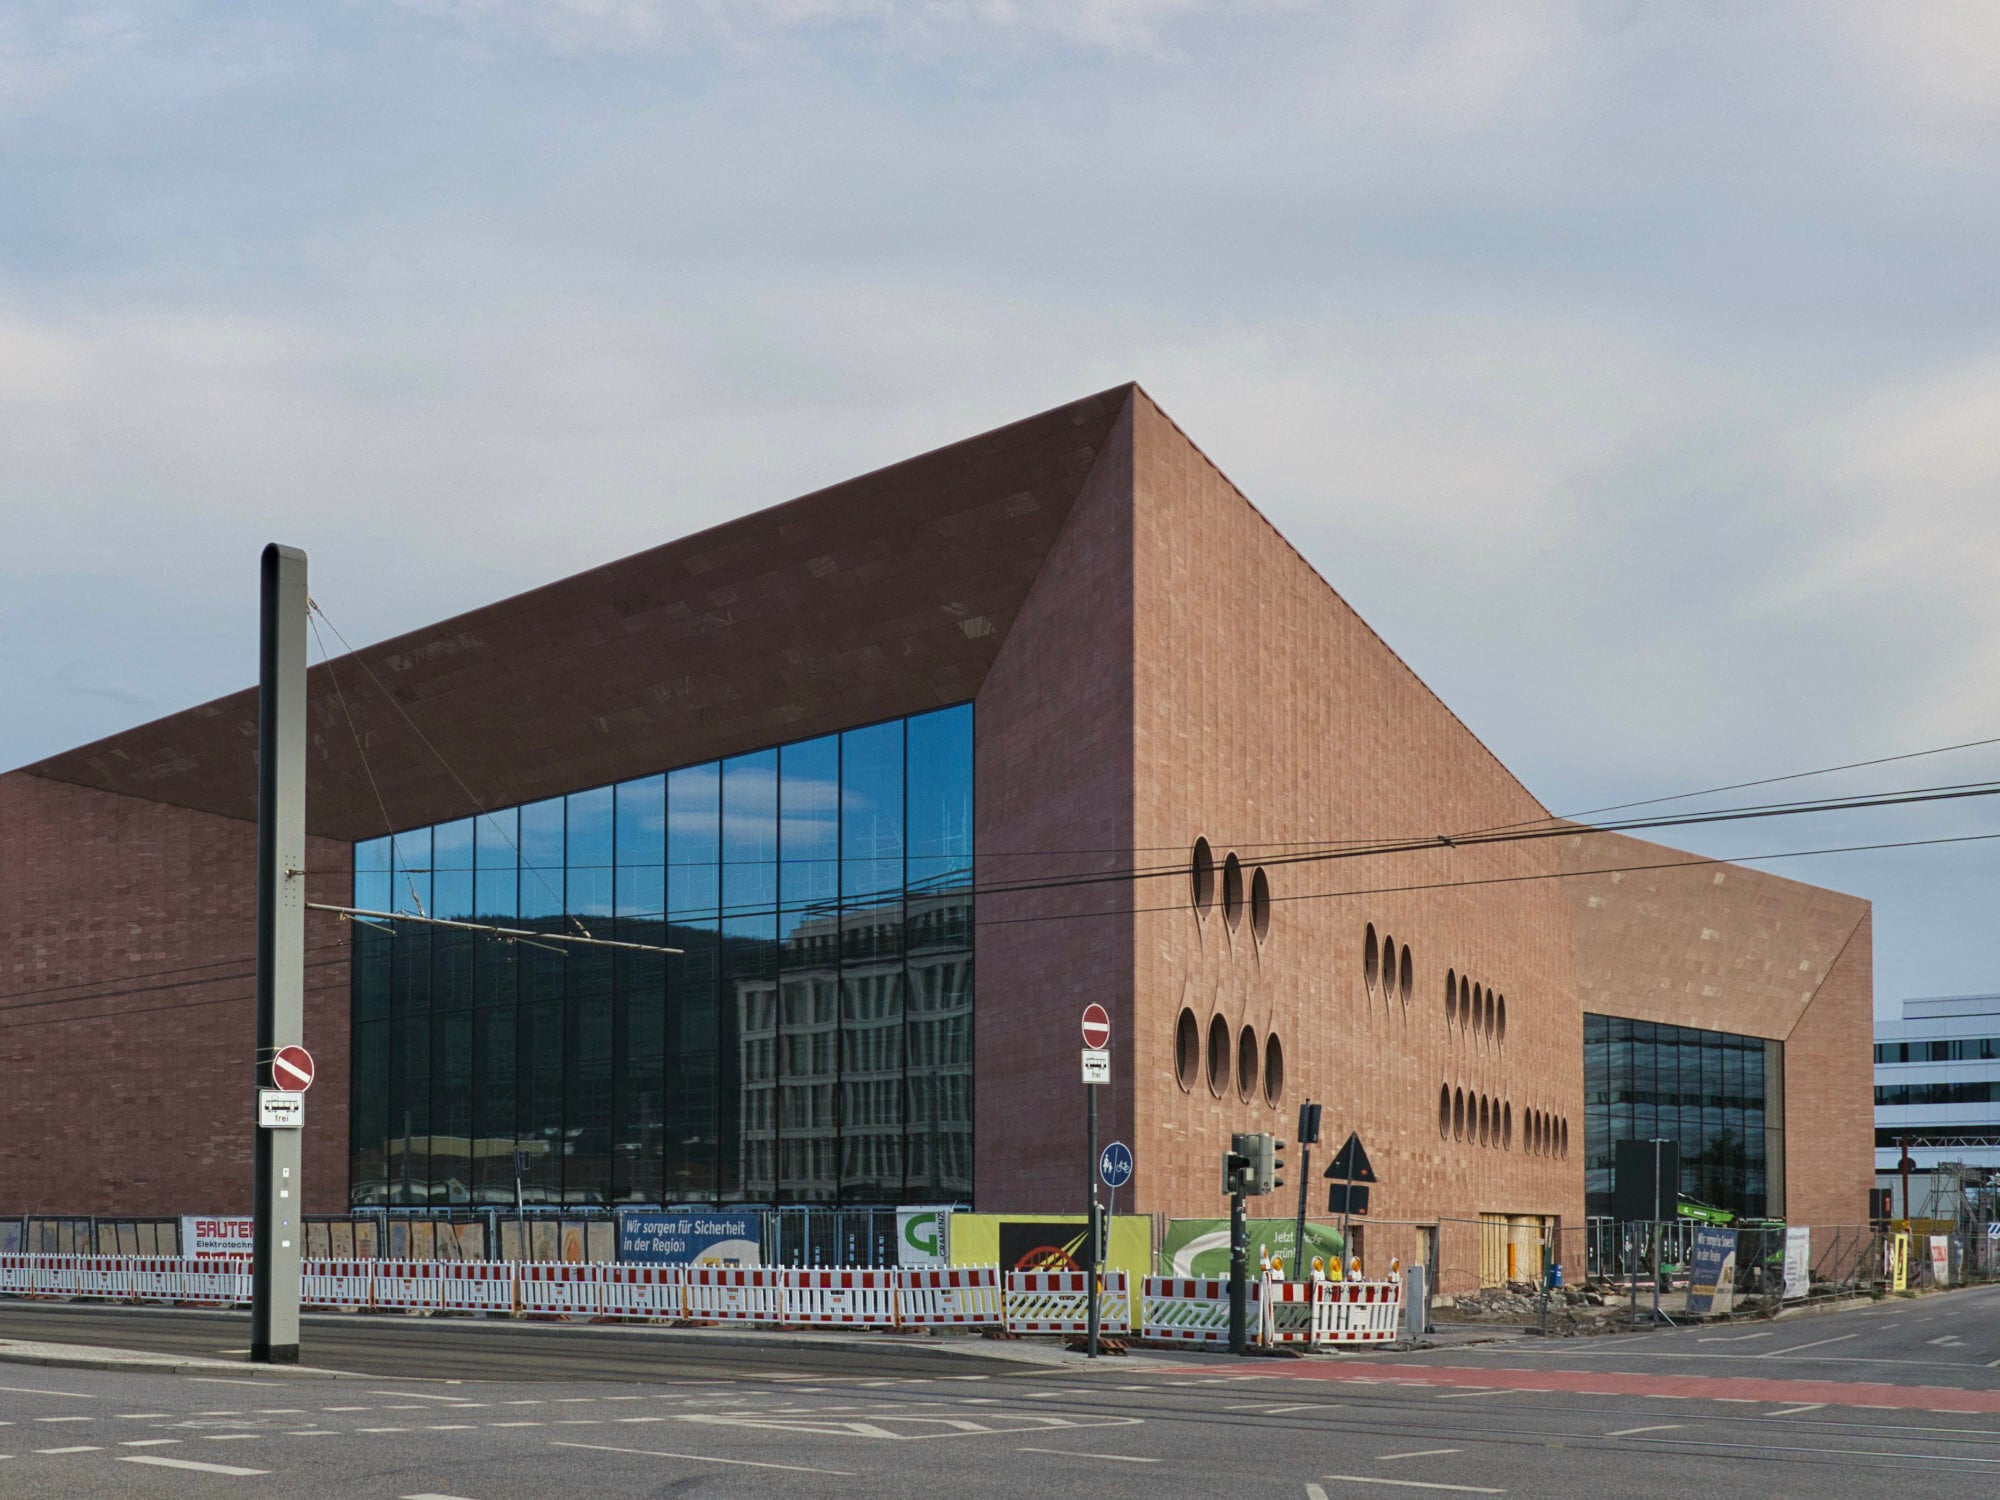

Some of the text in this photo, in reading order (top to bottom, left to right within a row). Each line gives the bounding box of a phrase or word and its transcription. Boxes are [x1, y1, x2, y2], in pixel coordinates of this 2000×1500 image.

[275, 1113, 289, 1122] frei
[626, 1219, 745, 1236] Wir sorgen für Sicherheit
[1273, 1231, 1294, 1243] Jetzt
[623, 1237, 686, 1255] in der Region
